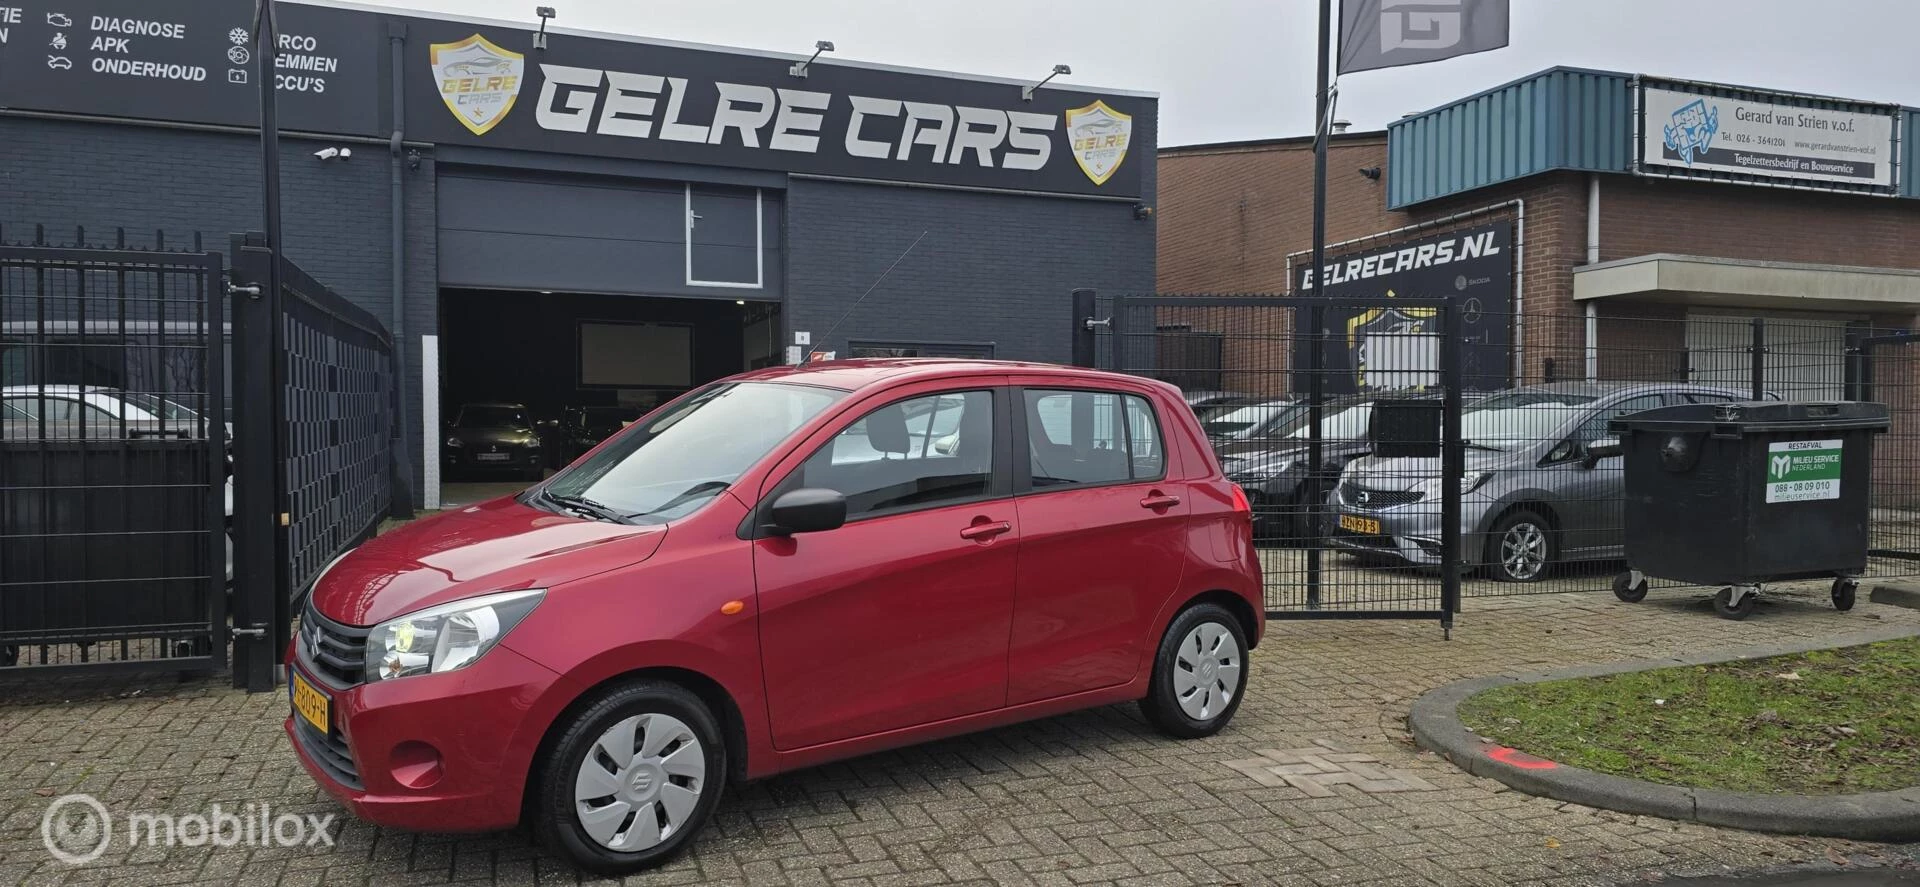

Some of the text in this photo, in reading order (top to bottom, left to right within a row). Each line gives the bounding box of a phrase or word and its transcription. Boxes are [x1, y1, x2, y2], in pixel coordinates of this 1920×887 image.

[90, 15, 186, 39] DIAGNOSE
[90, 36, 129, 53] APK
[277, 33, 316, 51] RCO
[92, 57, 207, 82] ONDERHOUD
[275, 53, 338, 72] EMMEN
[275, 74, 325, 93] CCU'S
[442, 75, 518, 93] GELRE
[457, 92, 502, 104] CARS
[535, 63, 1058, 170] GELRE CARS
[1735, 106, 1855, 133] Gerard van Strien v.o.f.
[1074, 133, 1127, 151] GELRE
[1721, 132, 1733, 142] Tel.
[1736, 133, 1751, 143] 026
[1734, 153, 1854, 174] Tegelzettersbedrijf en Bouwservice
[1788, 442, 1823, 450] RESTAFVAL
[1792, 463, 1826, 472] NEDERLAND
[1793, 454, 1840, 465] MILIEU SERVICE
[1794, 483, 1803, 492] 08
[1804, 482, 1814, 491] 09
[1815, 481, 1831, 490] 010
[294, 675, 326, 728] -809-H
